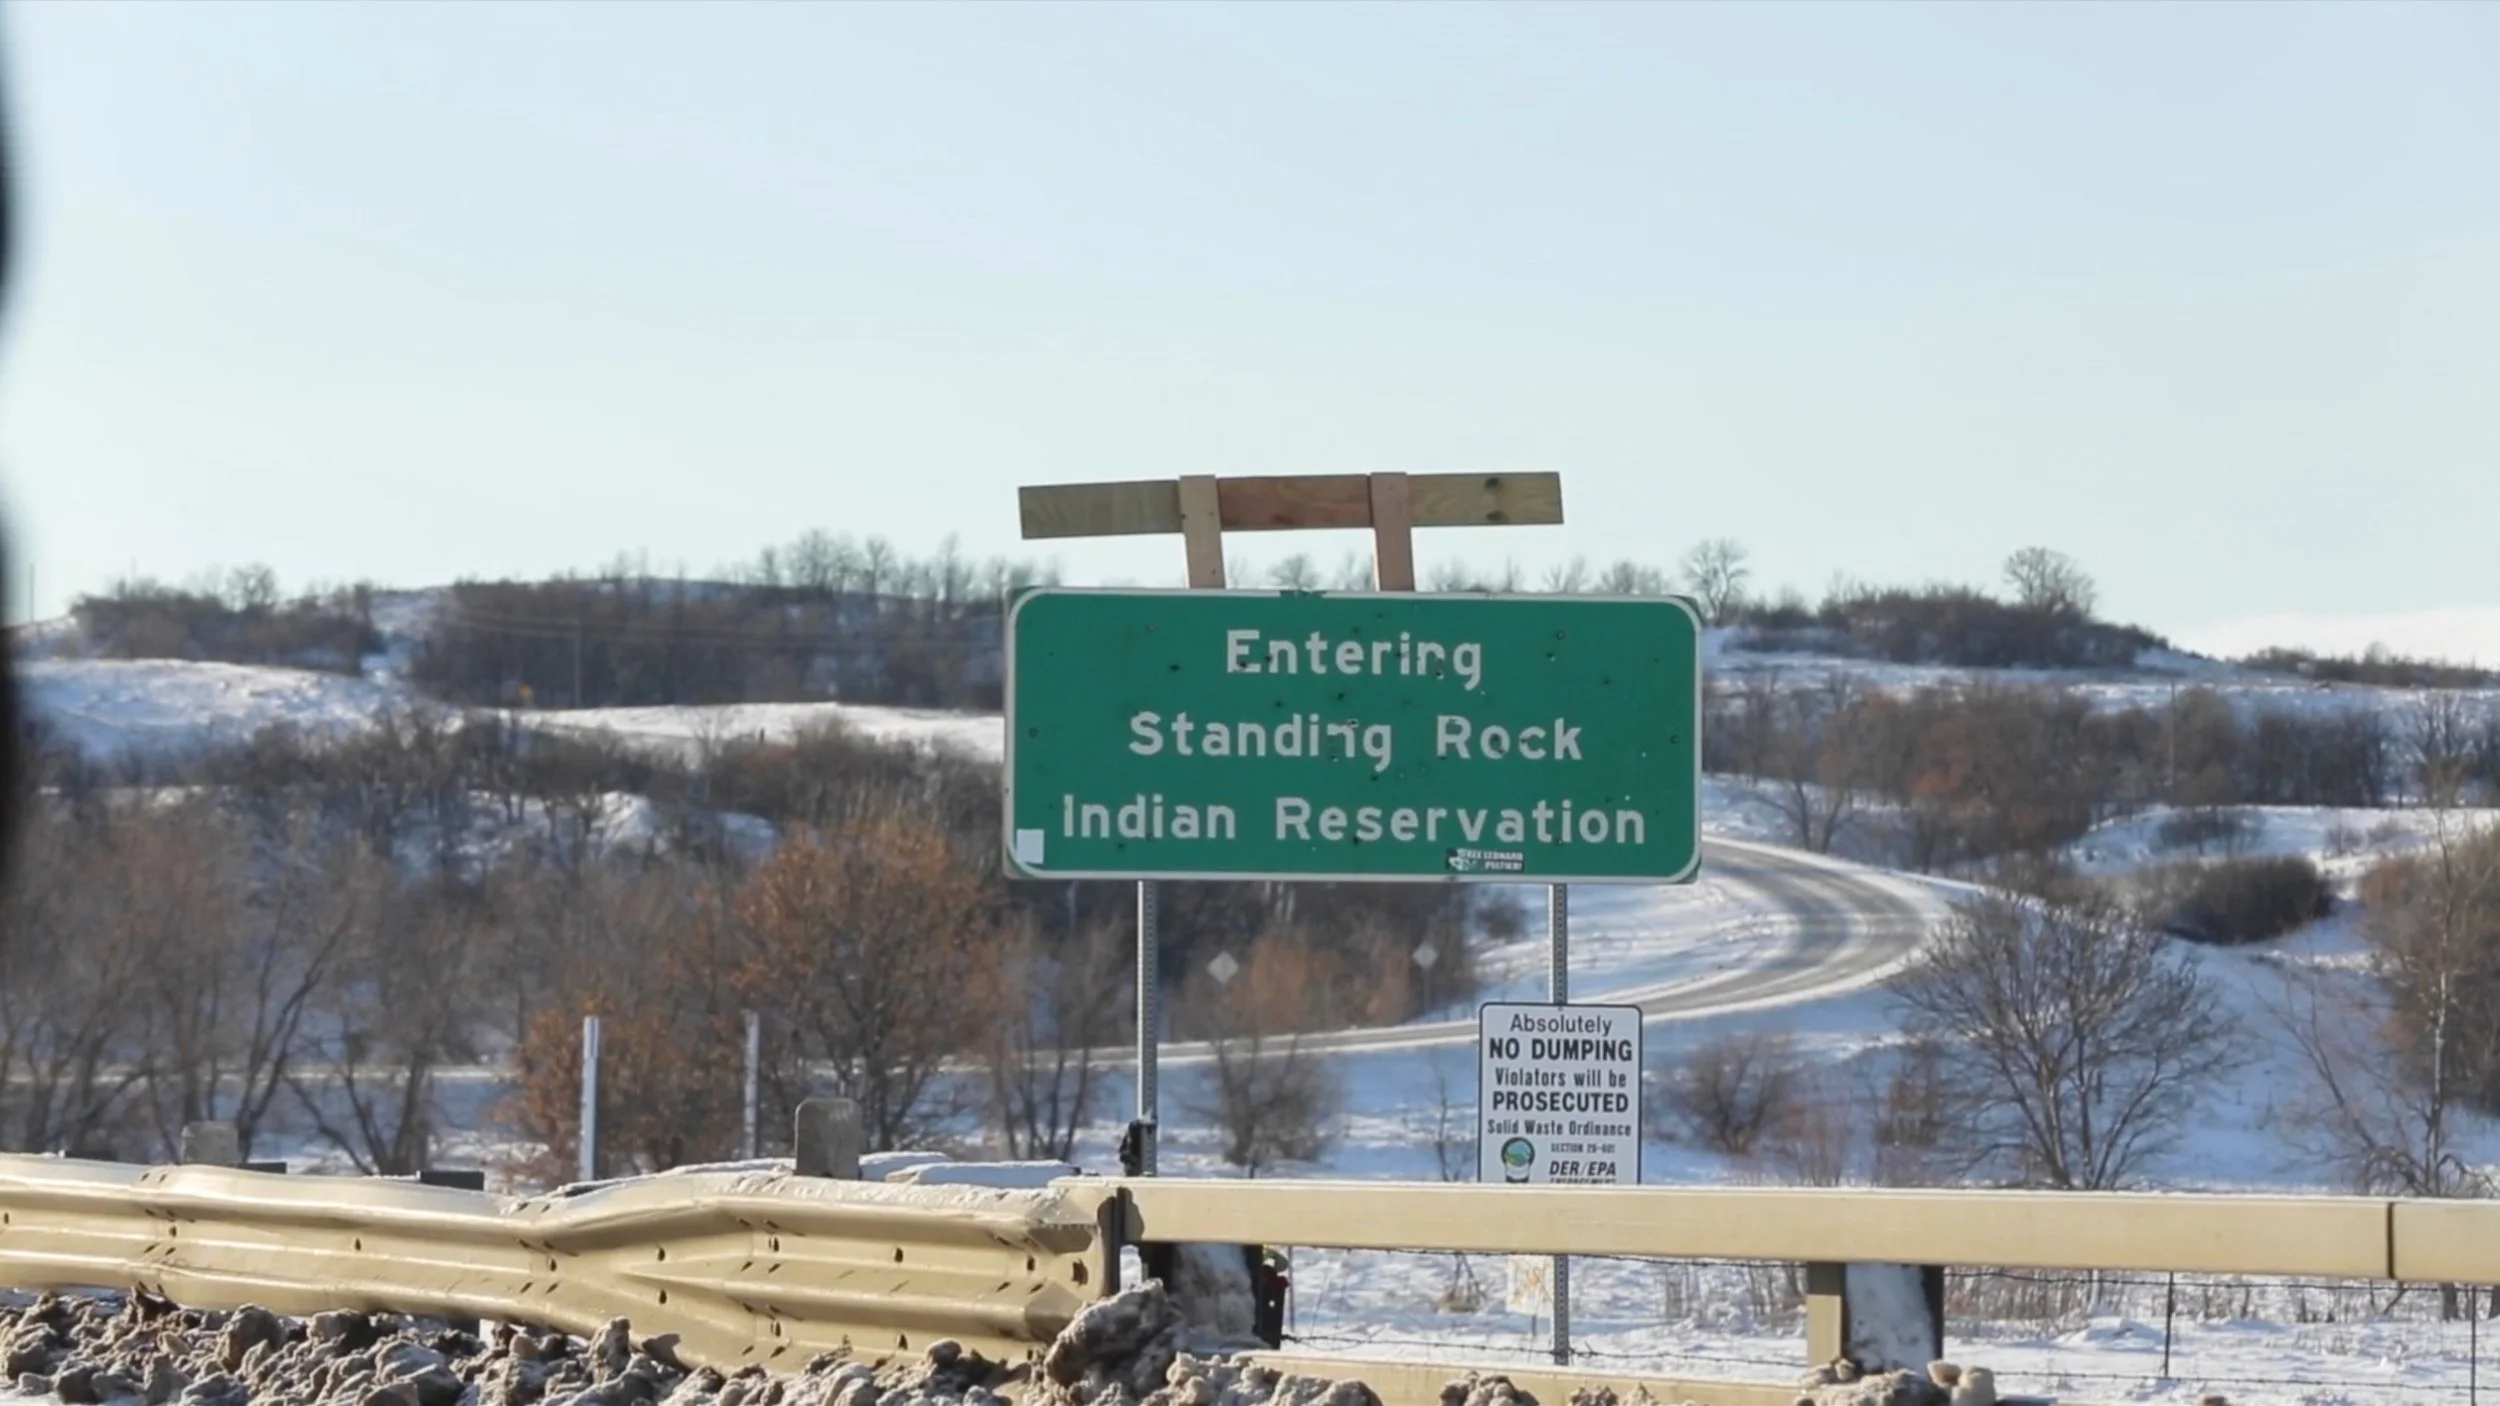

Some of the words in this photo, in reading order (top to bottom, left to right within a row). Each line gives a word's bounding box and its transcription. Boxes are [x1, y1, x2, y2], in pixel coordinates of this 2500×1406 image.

[1226, 629, 1482, 690] Entering
[1128, 711, 1392, 772] Standing
[1436, 715, 1583, 761] Rock
[1063, 794, 1237, 840] Indian
[1275, 797, 1646, 844] Reservation
[1510, 1013, 1613, 1037] Absolutely
[1489, 1038, 1520, 1060] NO
[1531, 1038, 1633, 1061] DUMPING
[1495, 1067, 1566, 1087] Violators
[1574, 1069, 1602, 1087] will
[1608, 1069, 1627, 1087] be
[1492, 1091, 1629, 1113] PROSECUTED
[1487, 1119, 1519, 1135] Solid
[1524, 1120, 1564, 1136] Waste
[1569, 1121, 1632, 1137] Ordinance
[1551, 1143, 1583, 1153] SECTION
[1549, 1160, 1617, 1177] DER/EPA
